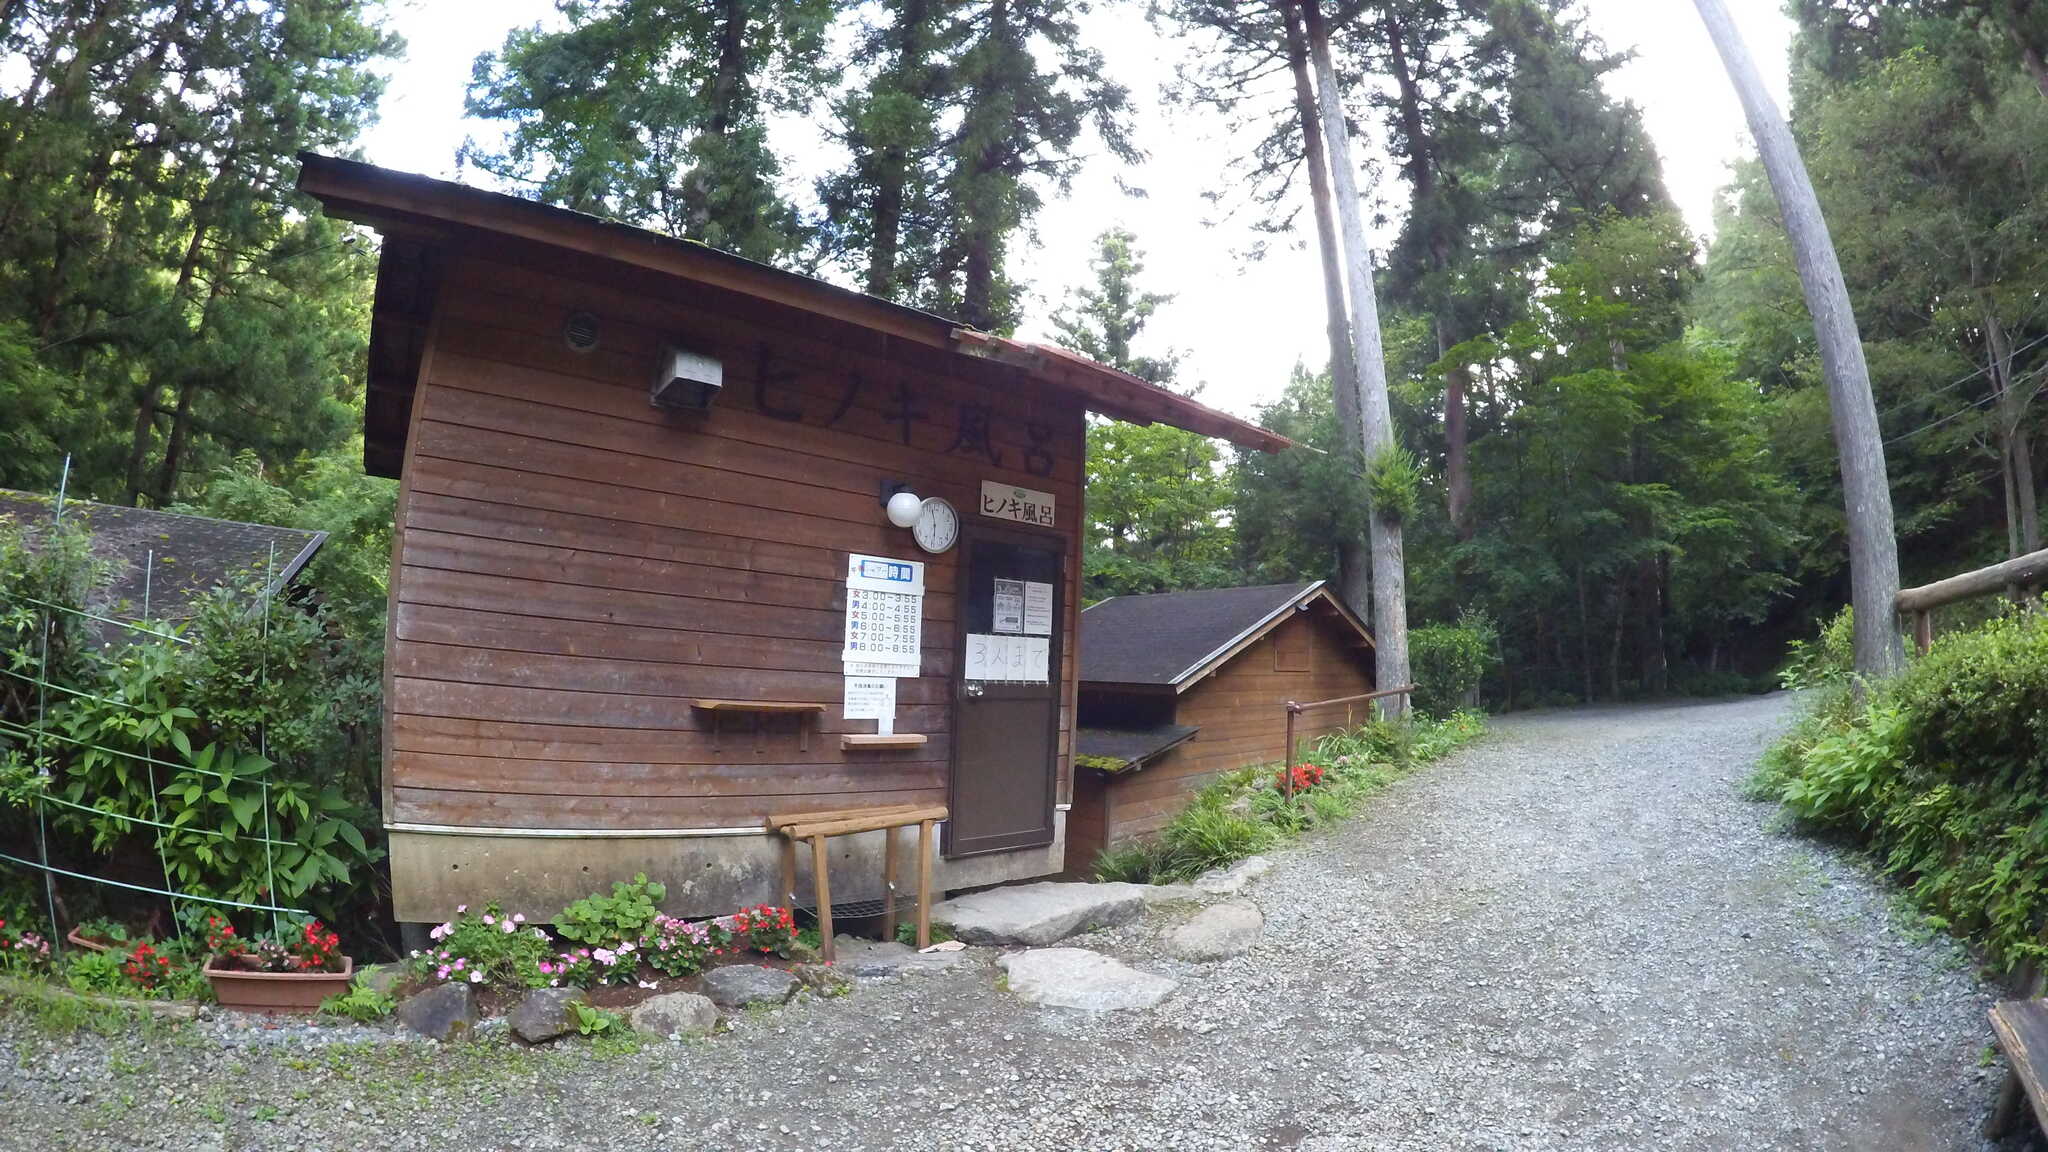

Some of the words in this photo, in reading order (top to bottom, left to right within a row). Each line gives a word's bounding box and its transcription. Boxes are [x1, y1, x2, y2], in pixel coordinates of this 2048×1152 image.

[755, 341, 1055, 476] ヒノキ風呂
[983, 494, 1053, 525] ヒノキ風呂
